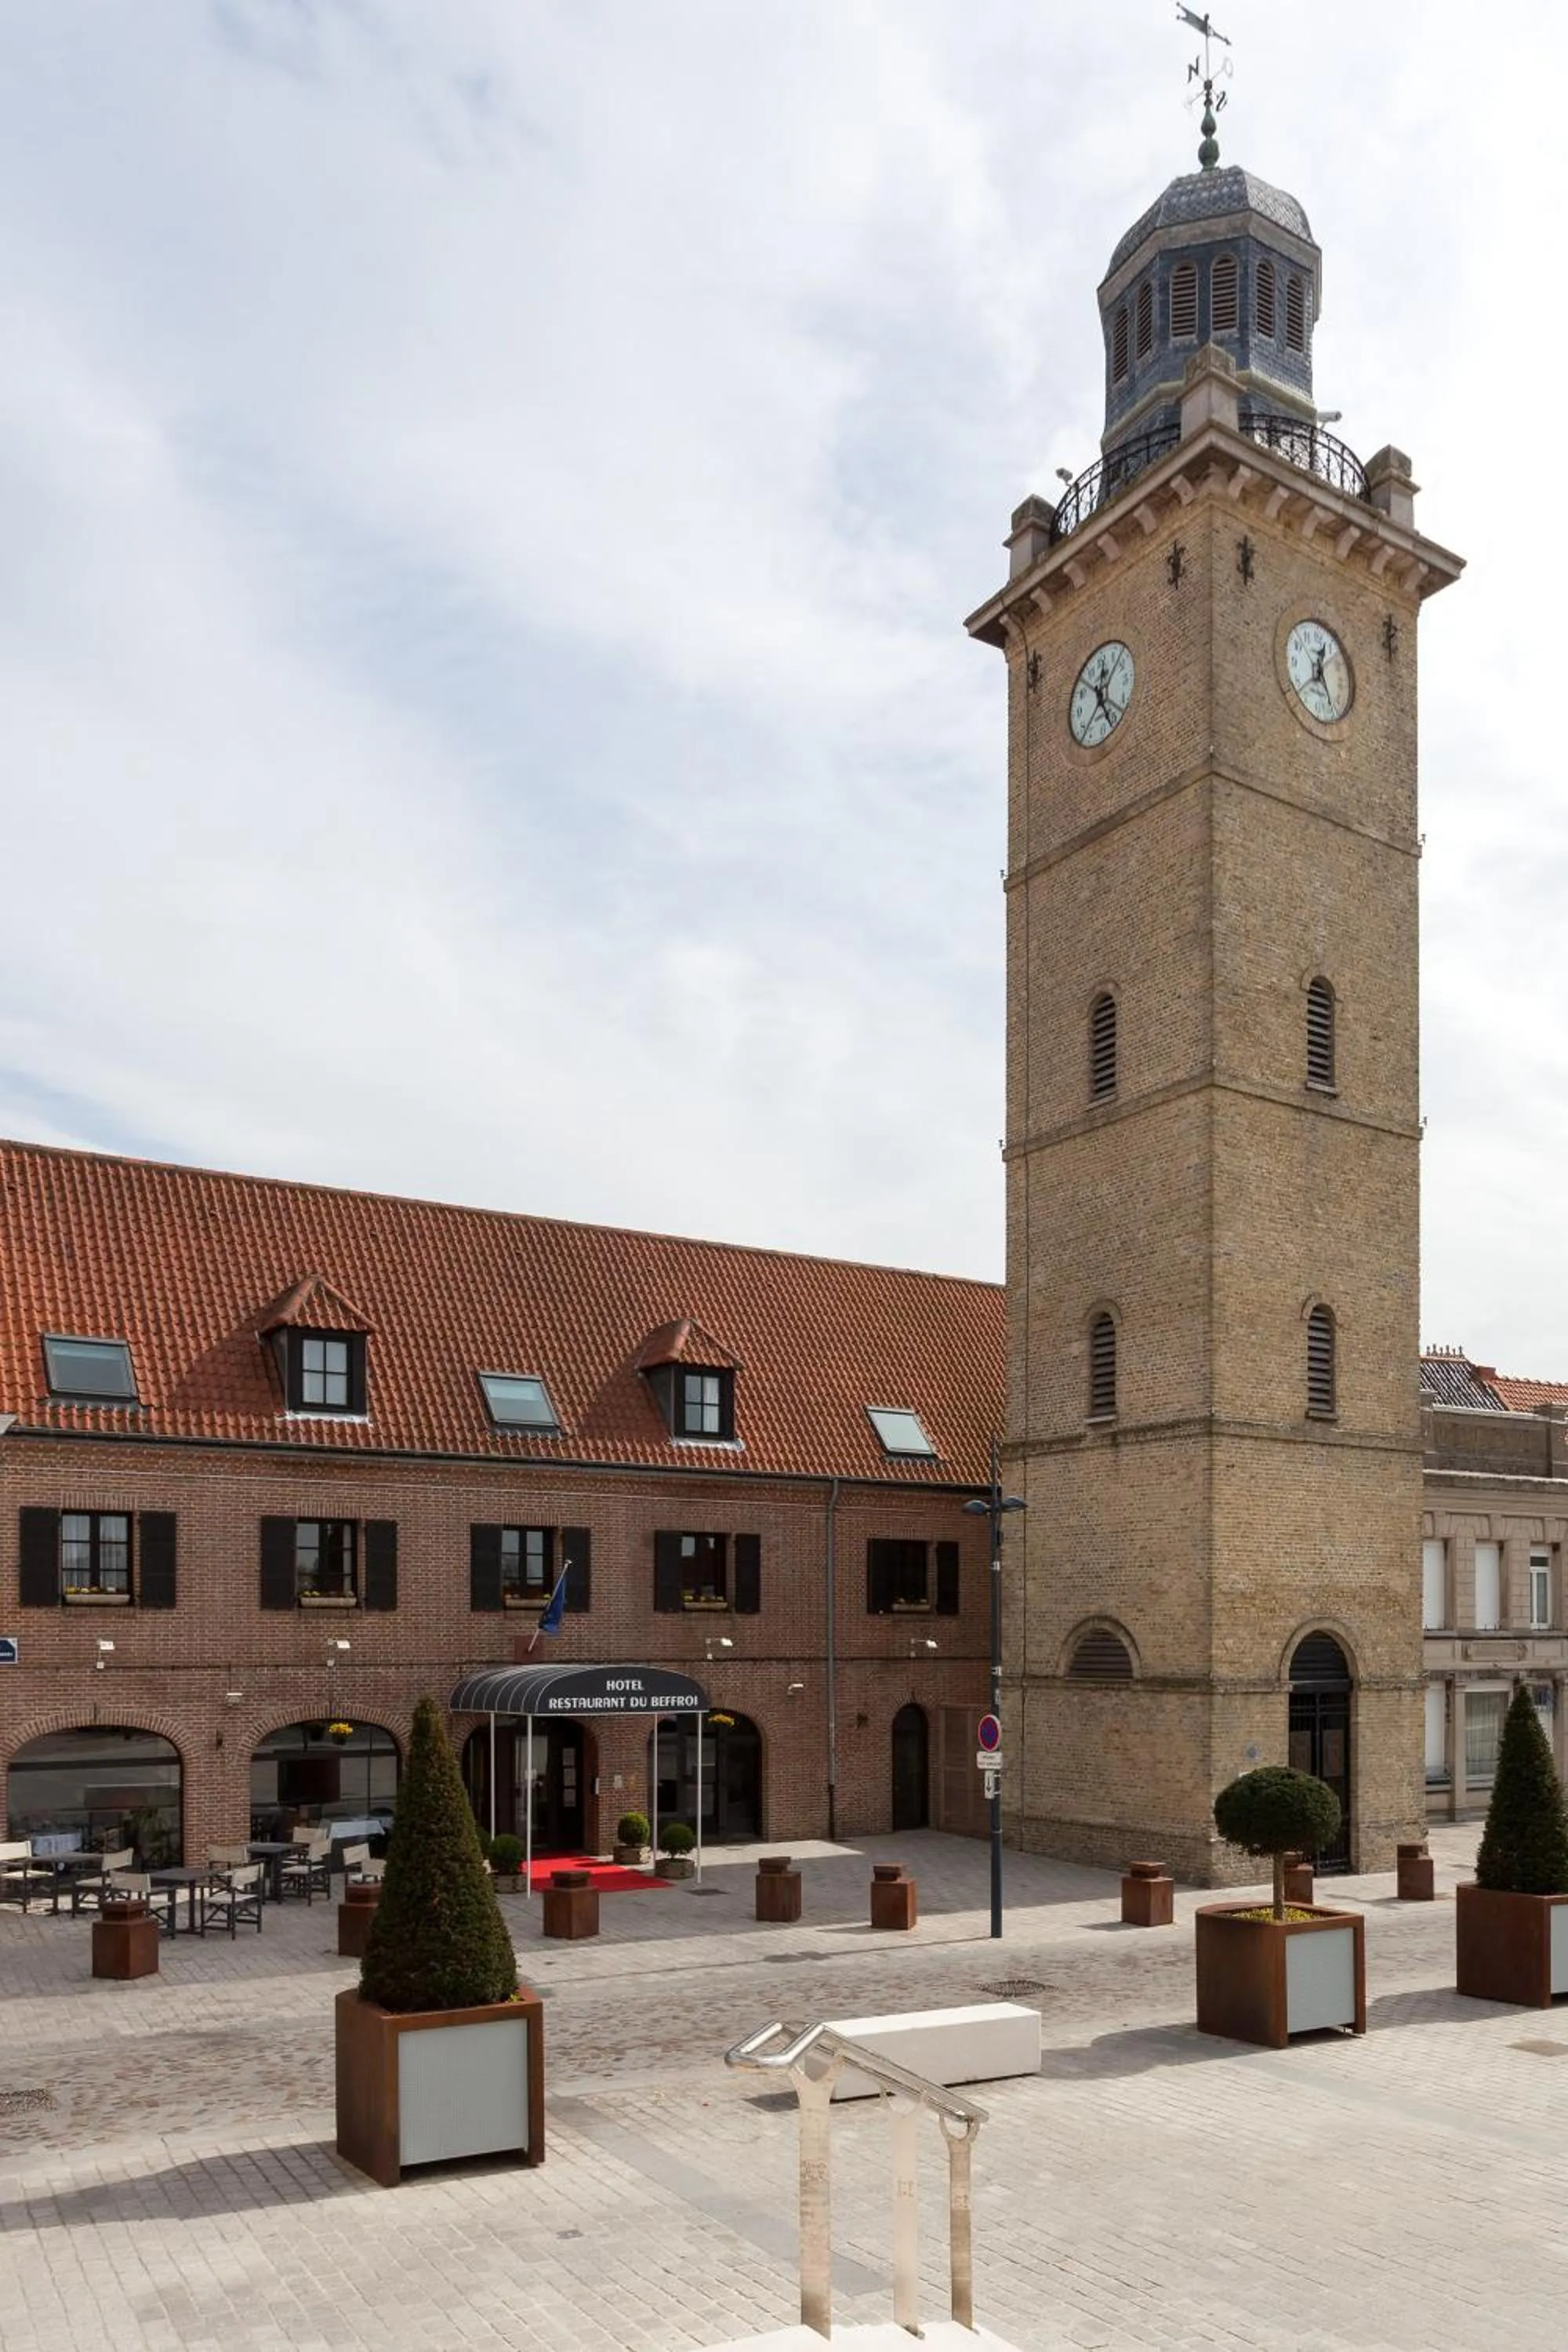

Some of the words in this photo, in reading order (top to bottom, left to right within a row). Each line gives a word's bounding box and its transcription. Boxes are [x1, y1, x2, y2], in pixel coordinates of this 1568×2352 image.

[606, 1679, 644, 1691] HOTEL
[549, 1697, 626, 1709] RESTAURANT
[630, 1697, 647, 1708] DU
[651, 1695, 699, 1707] BEFFROI
